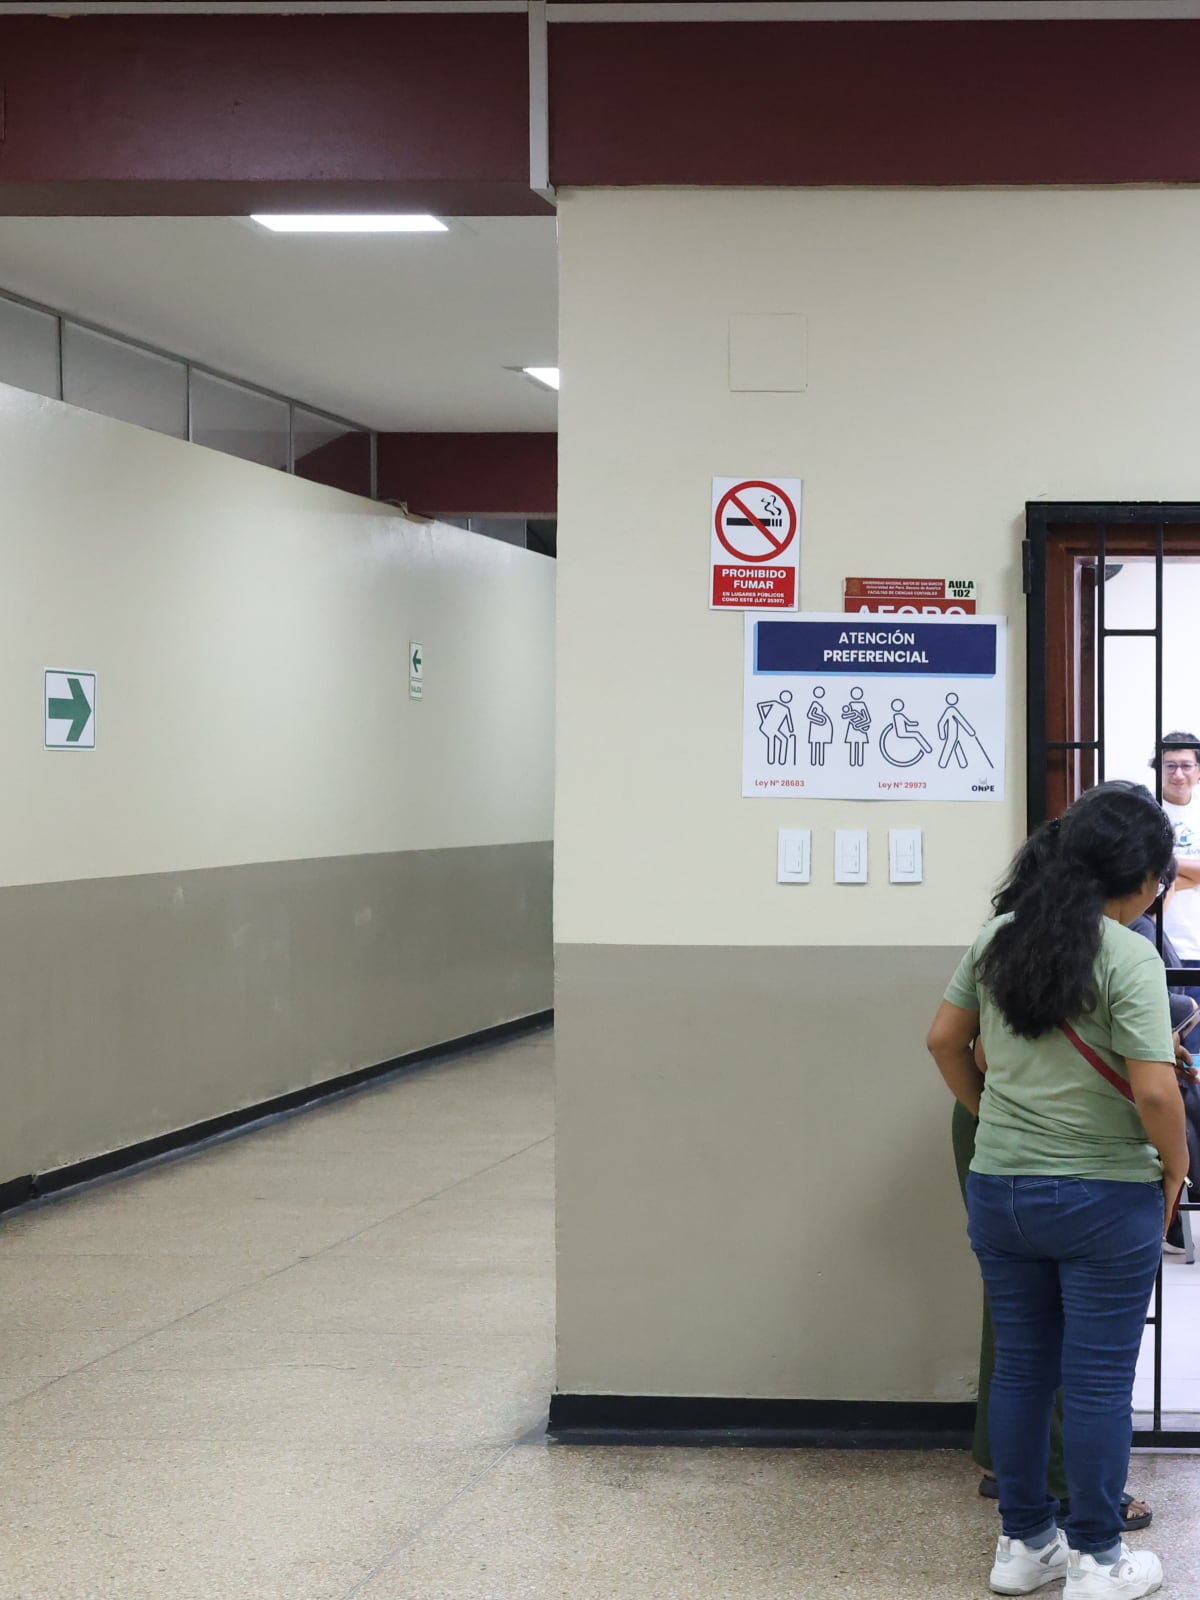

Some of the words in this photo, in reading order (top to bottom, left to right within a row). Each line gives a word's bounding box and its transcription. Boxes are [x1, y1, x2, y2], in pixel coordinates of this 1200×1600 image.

[722, 568, 787, 579] PROHIBIDO
[733, 580, 775, 590] FUMAR
[948, 580, 975, 589] AULA
[952, 589, 971, 598] 102
[838, 628, 915, 645] ATENCIÓN
[823, 649, 929, 663] PREFERENCIAL
[754, 779, 769, 788] Ley
[878, 781, 892, 790] Ley
